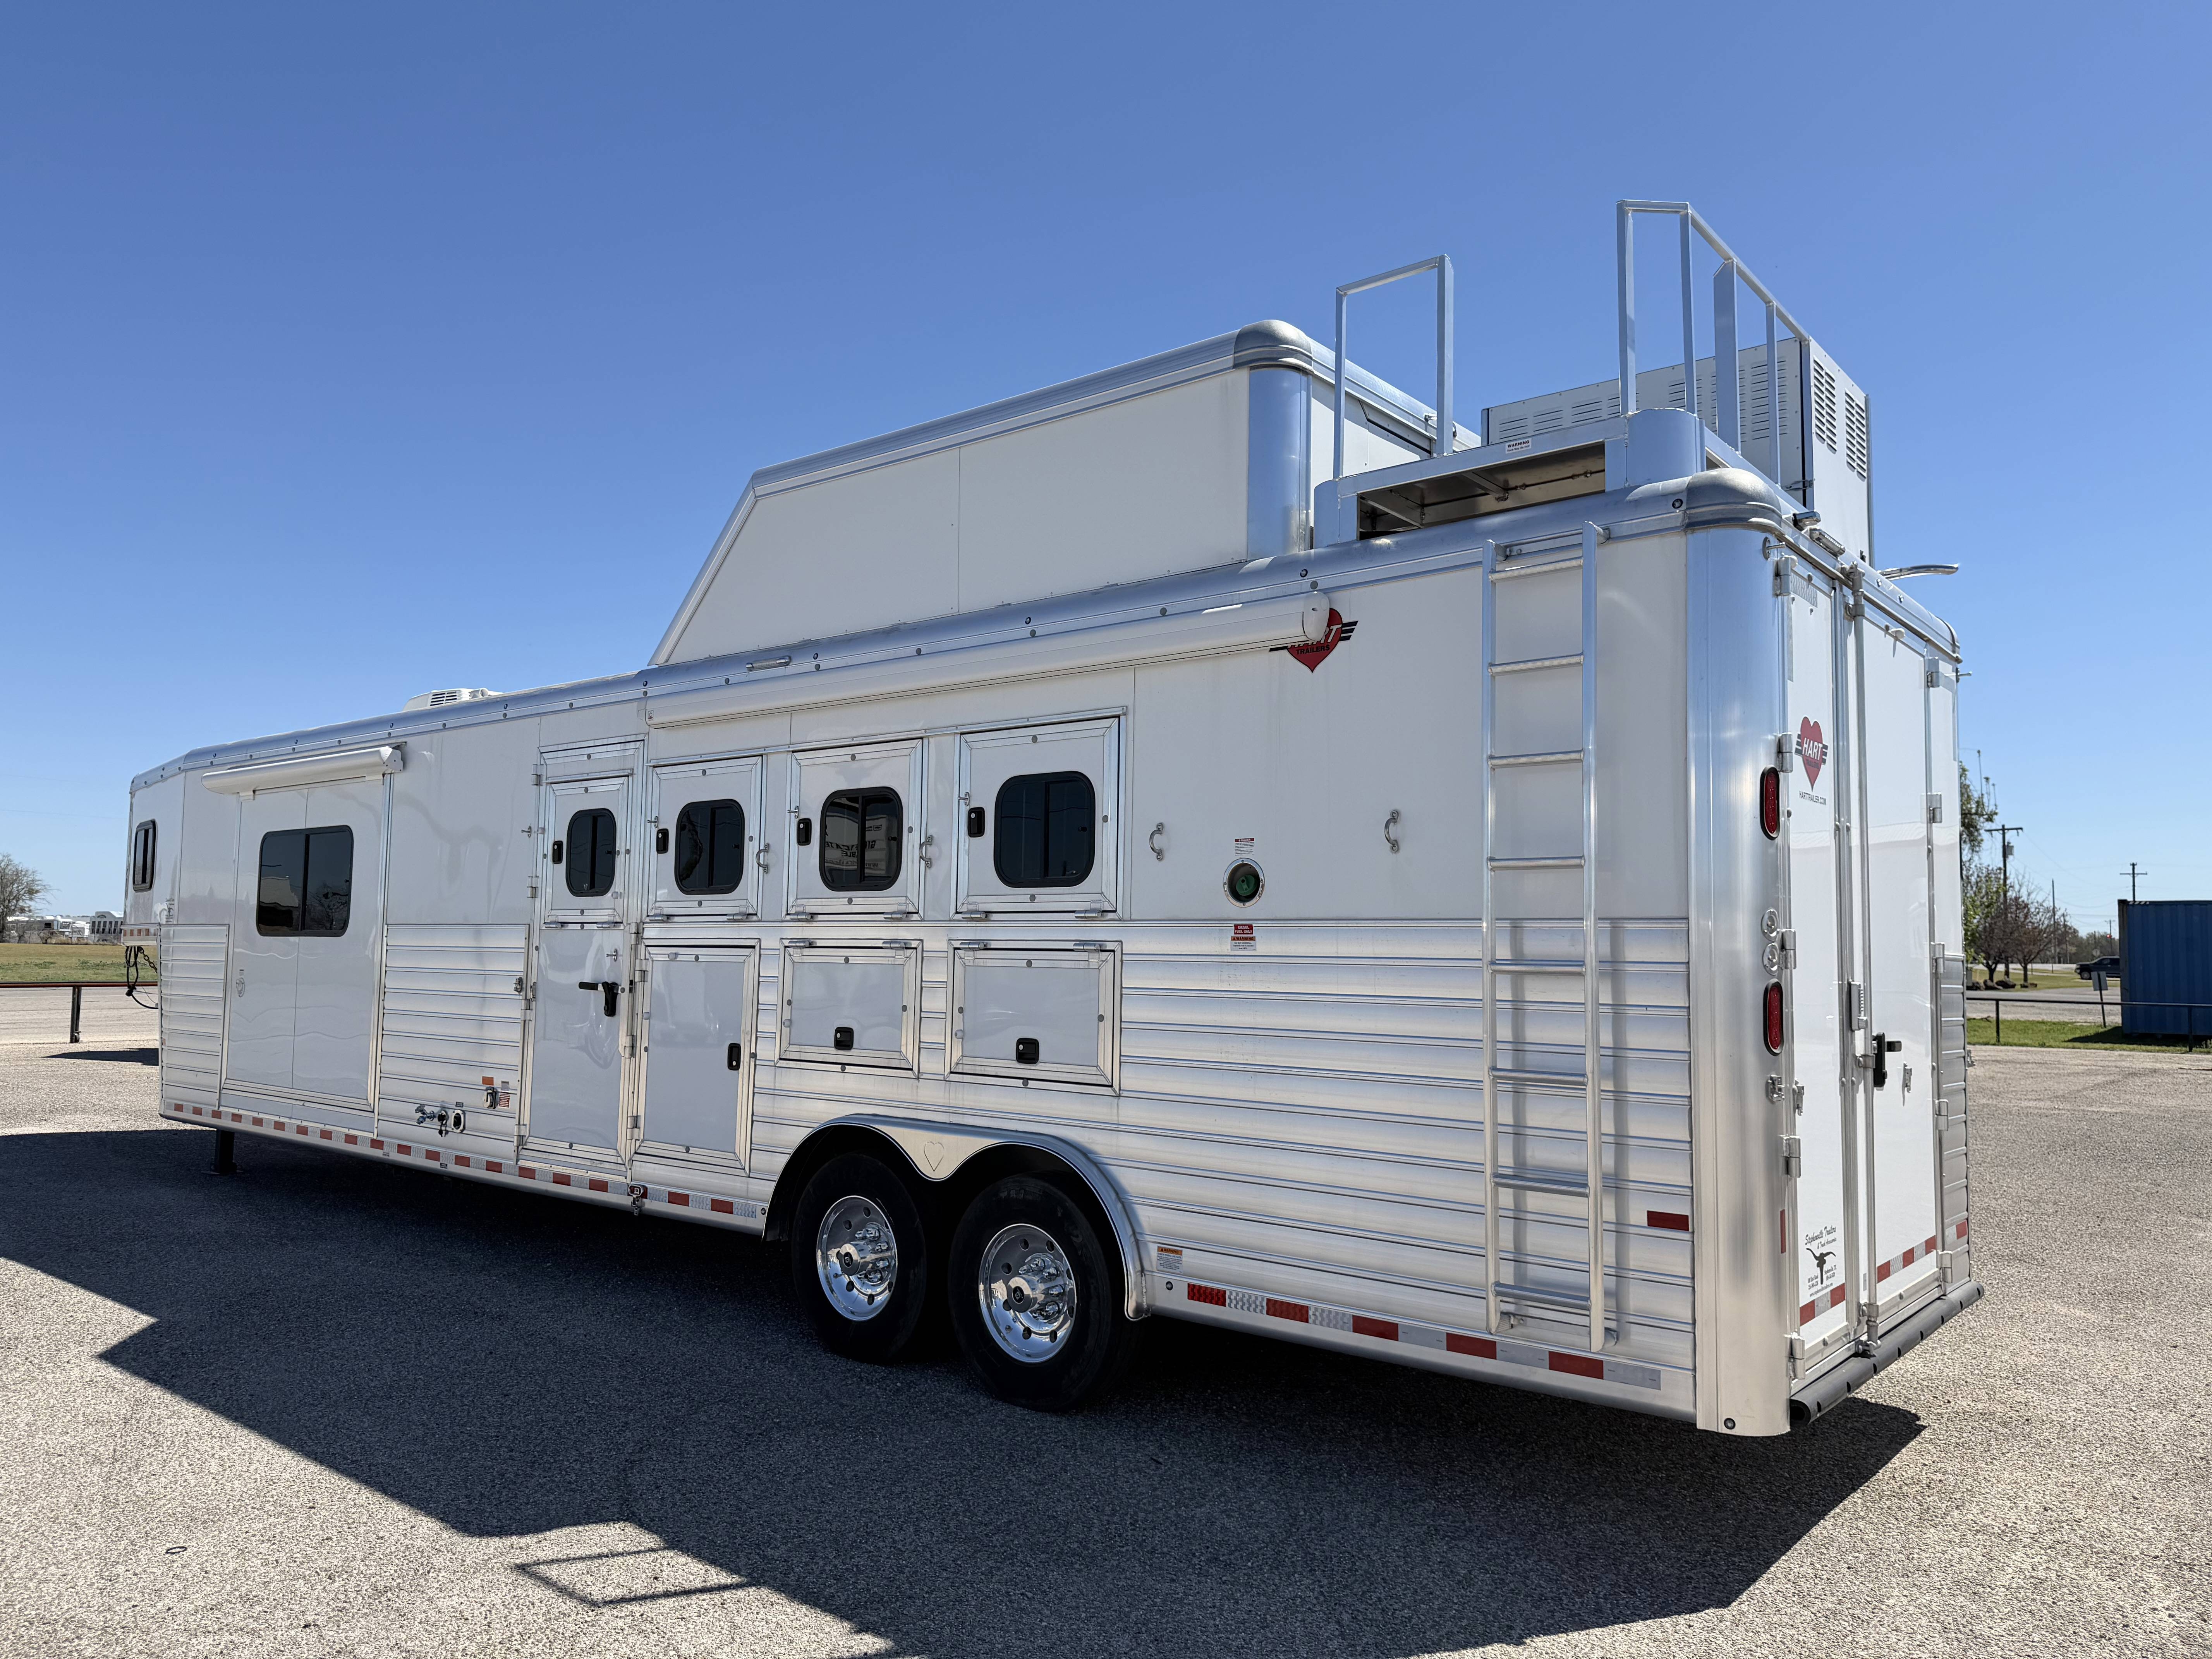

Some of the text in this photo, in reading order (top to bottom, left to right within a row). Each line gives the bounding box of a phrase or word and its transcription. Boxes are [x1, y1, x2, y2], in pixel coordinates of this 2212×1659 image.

[1296, 644, 1330, 655] TRAILERS
[1802, 737, 1823, 760] HART
[1799, 790, 1826, 805] HARTTRAILER.COM
